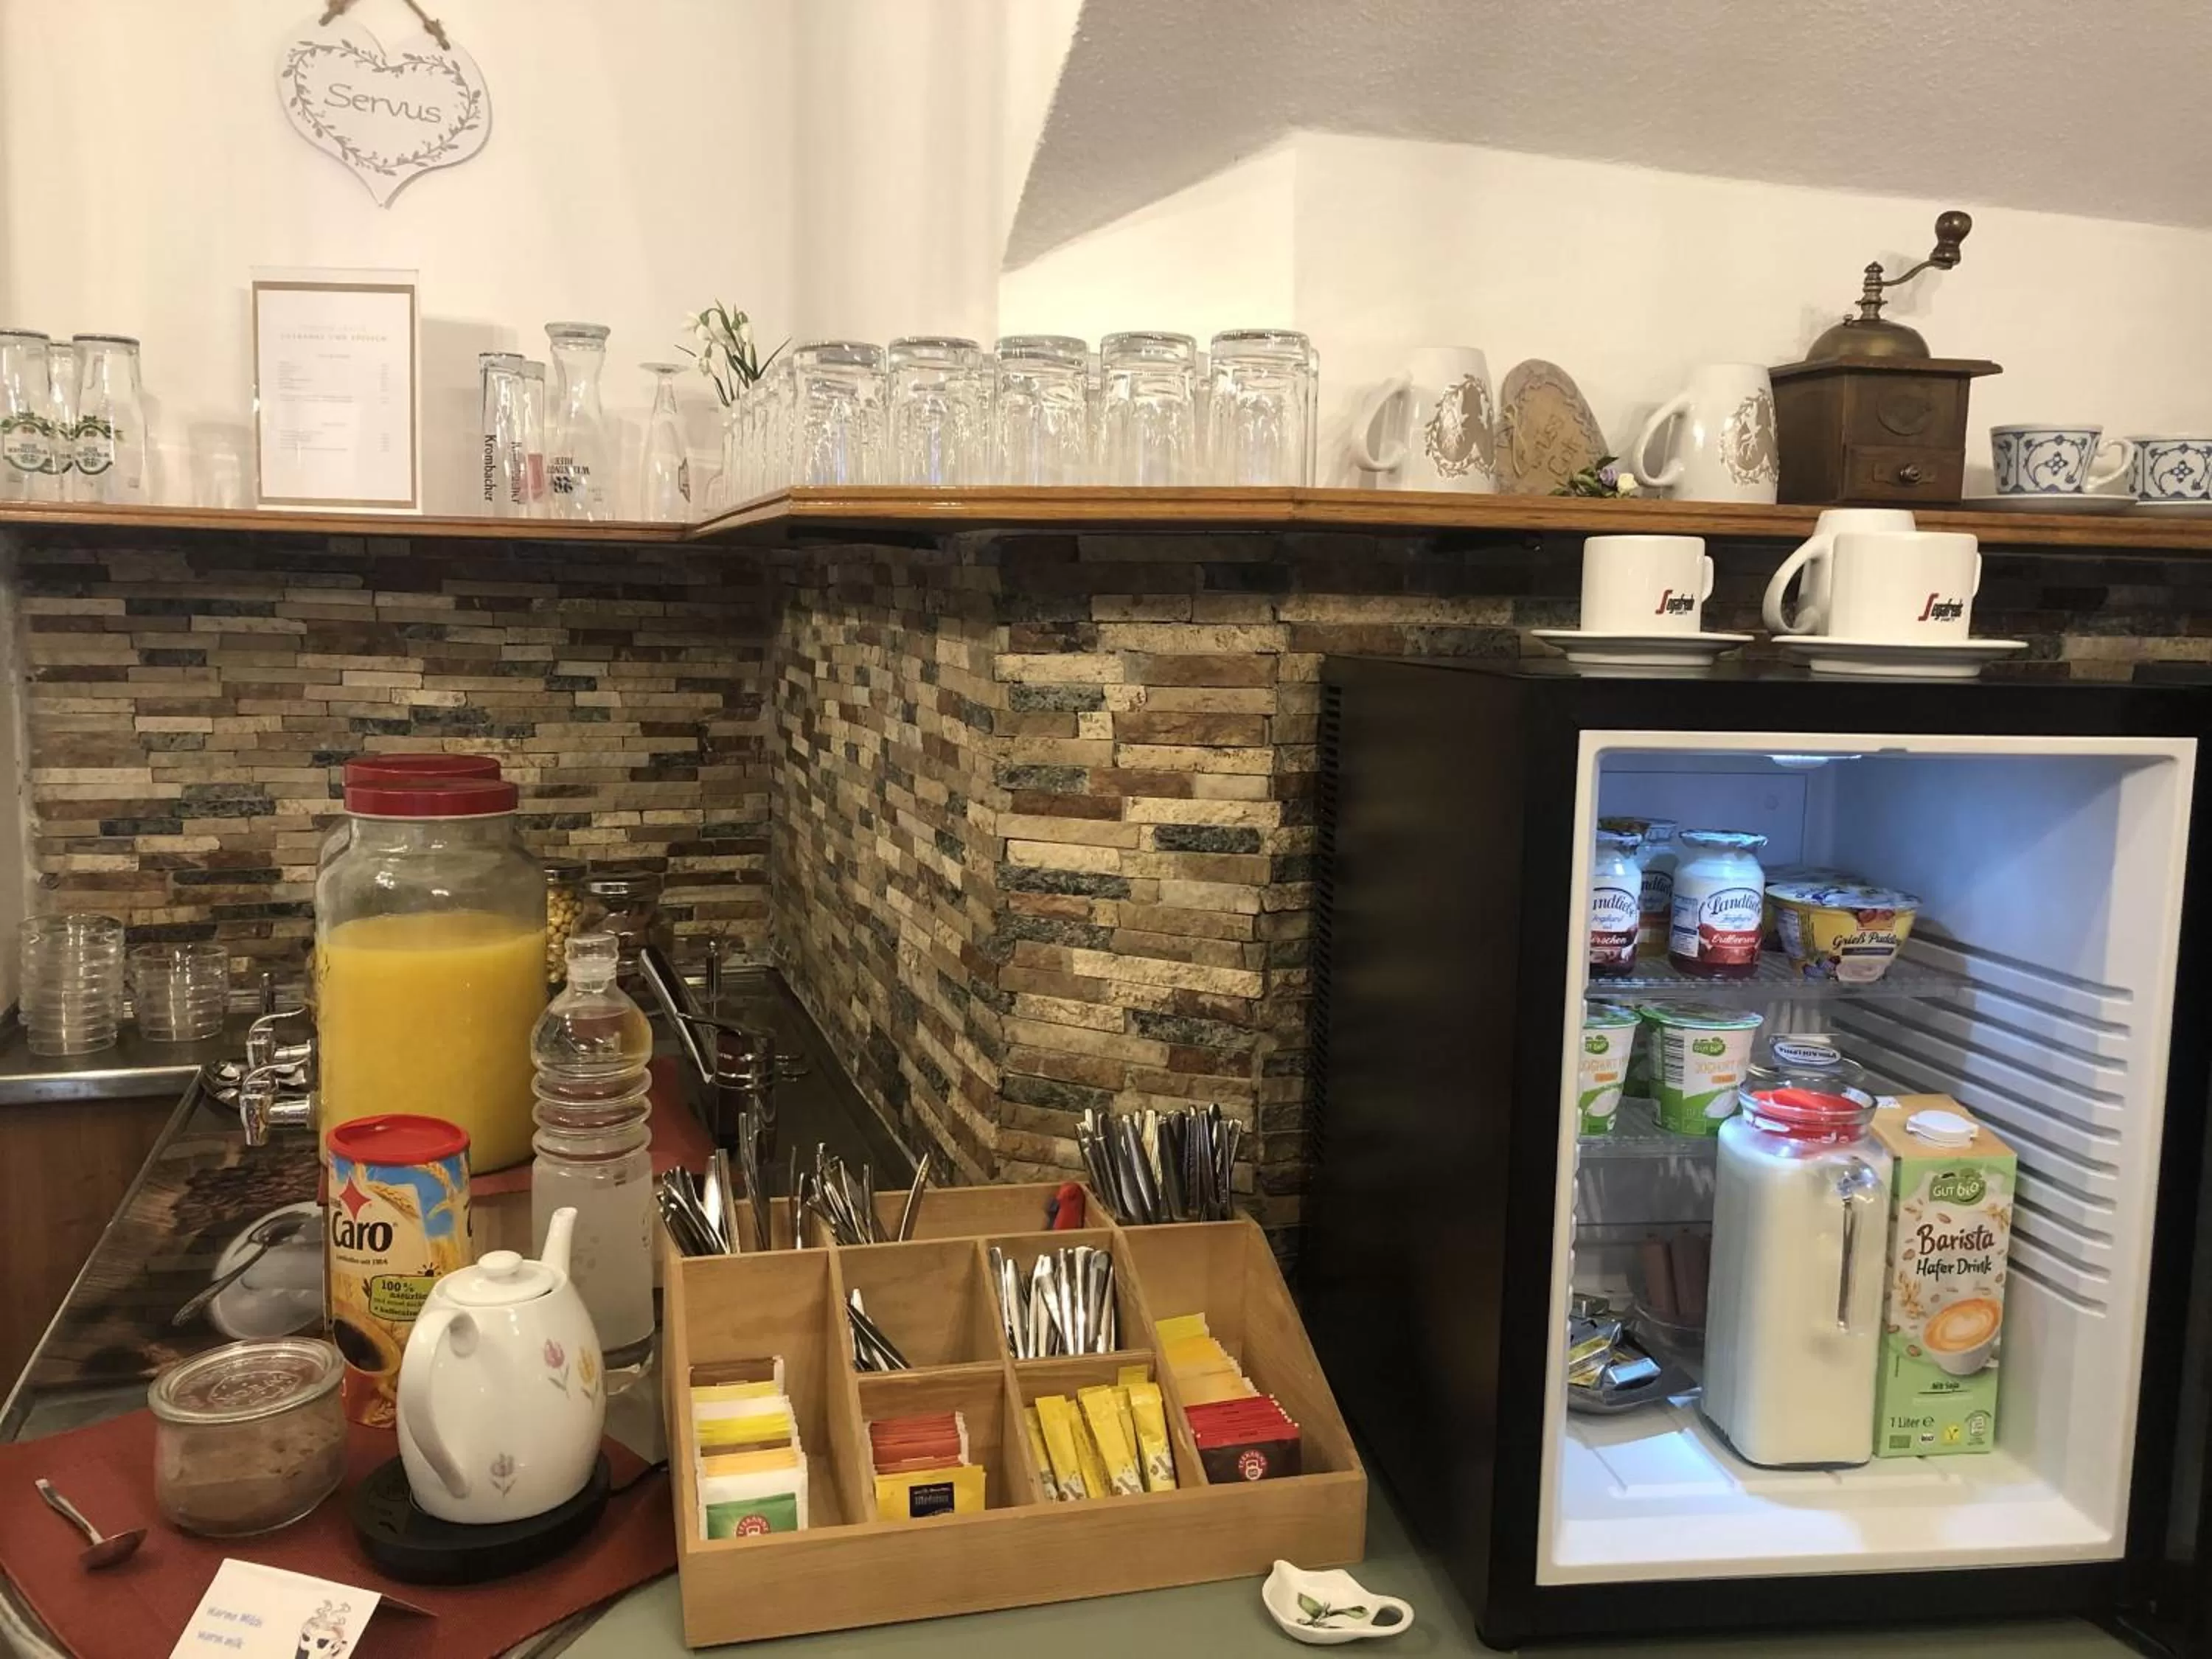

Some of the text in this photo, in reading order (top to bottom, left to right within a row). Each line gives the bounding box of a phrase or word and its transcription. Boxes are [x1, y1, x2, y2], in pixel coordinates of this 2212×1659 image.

[323, 83, 442, 124] Servus
[484, 434, 497, 502] Krombacher
[1933, 1186, 1955, 1197] GUT
[332, 1210, 393, 1252] Caro
[1916, 1223, 1995, 1256] Barista
[1916, 1255, 1992, 1281] Hafer Drink
[381, 1279, 402, 1292] 100
[1899, 1416, 1920, 1428] Liter
